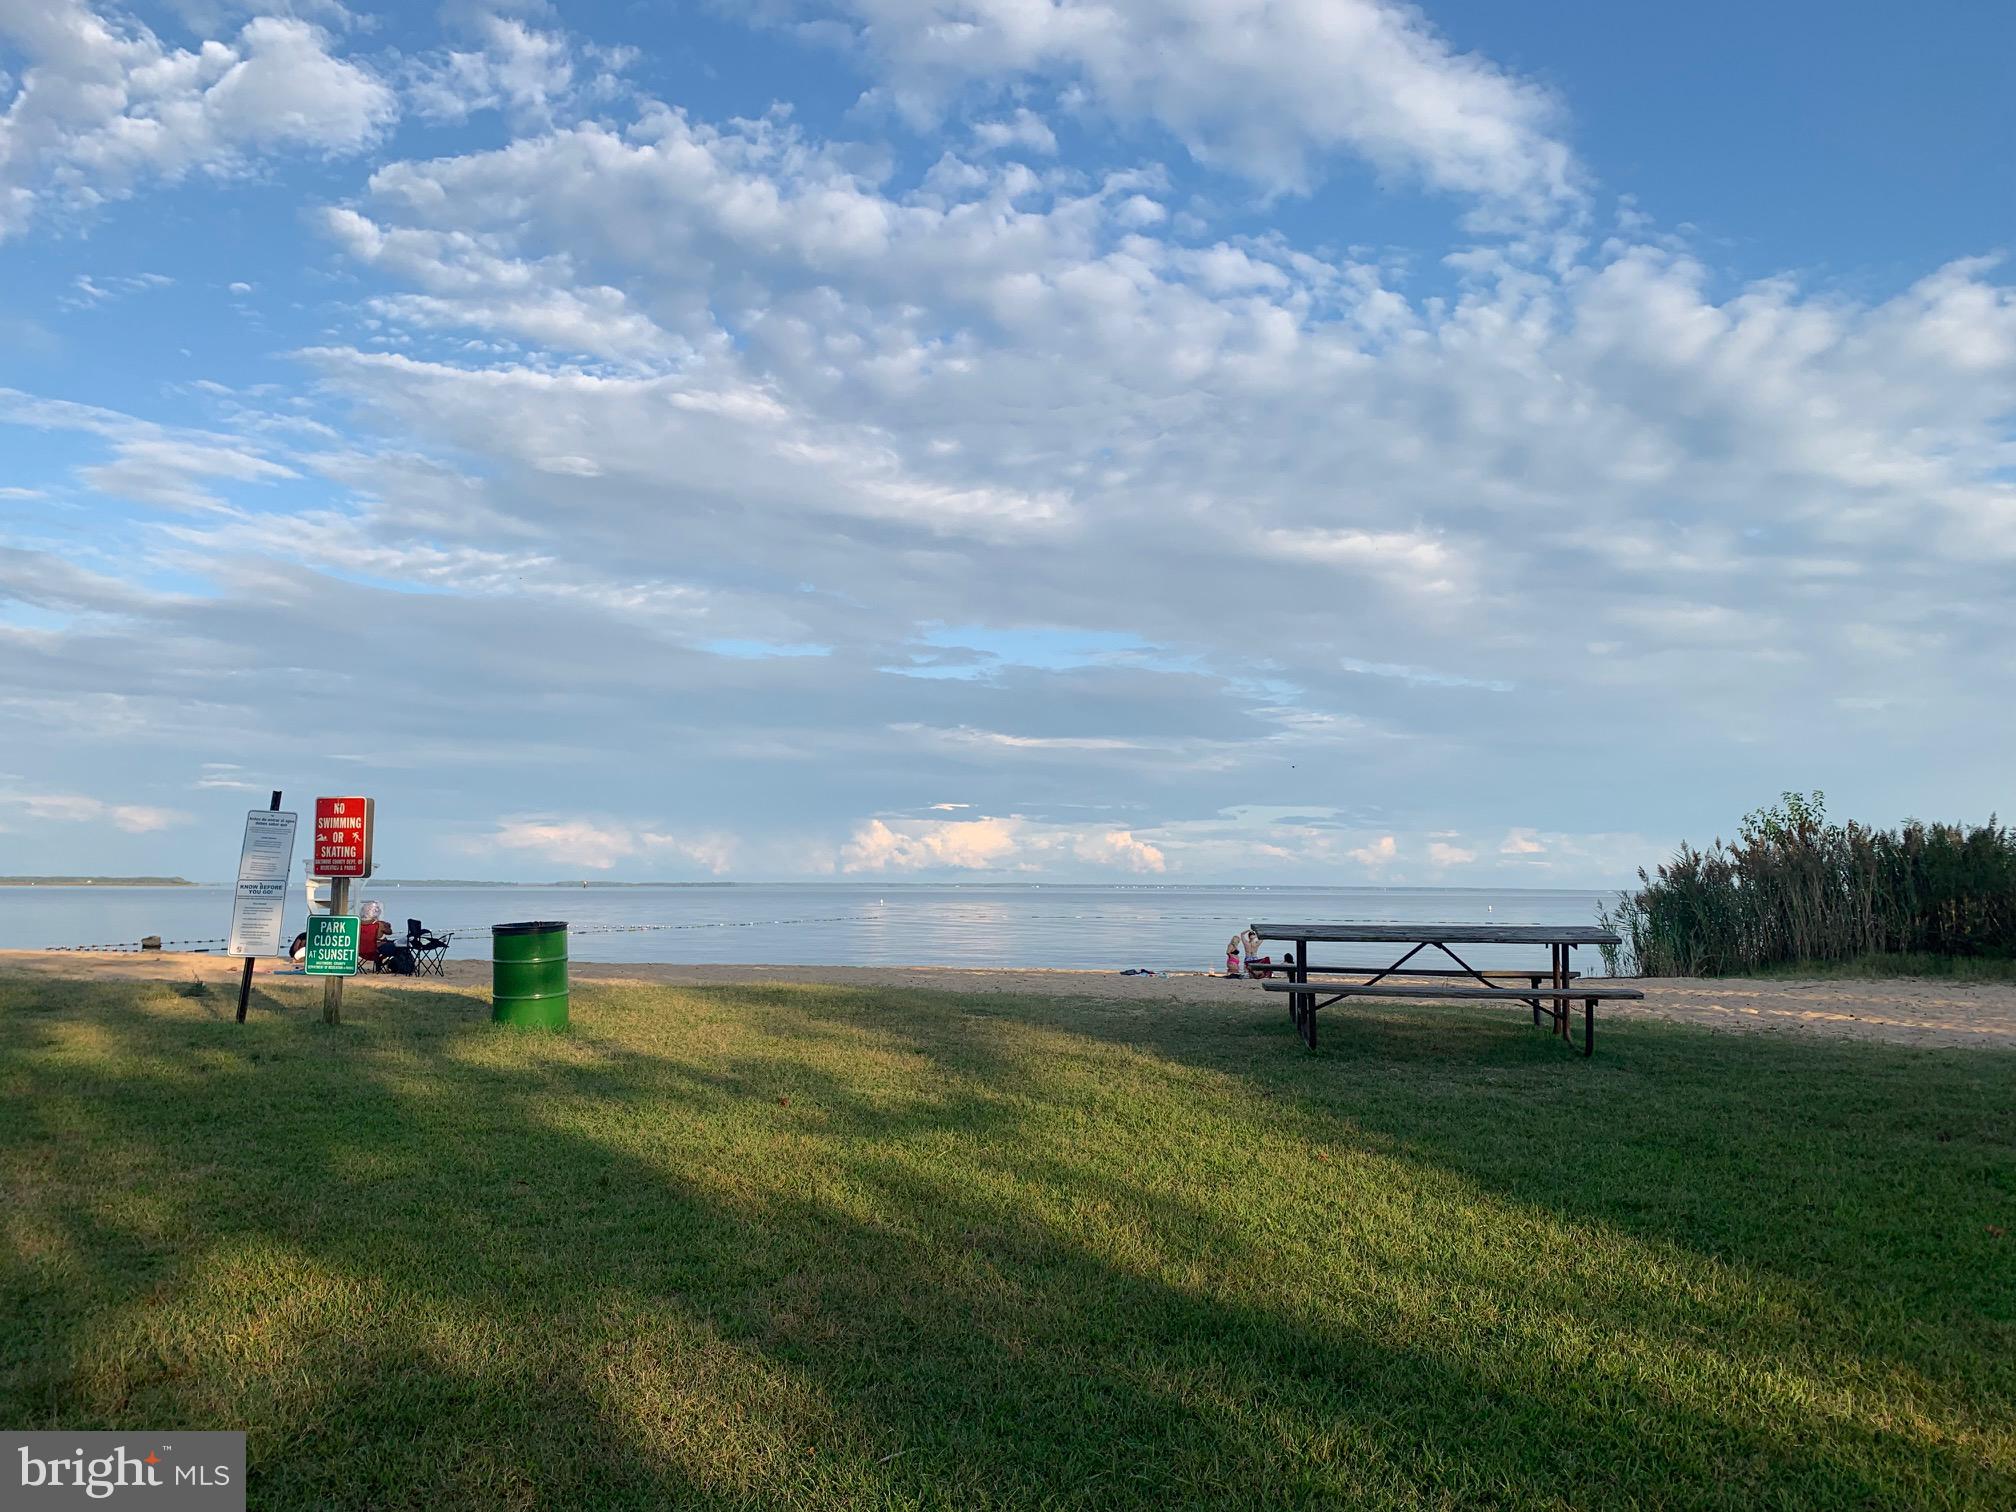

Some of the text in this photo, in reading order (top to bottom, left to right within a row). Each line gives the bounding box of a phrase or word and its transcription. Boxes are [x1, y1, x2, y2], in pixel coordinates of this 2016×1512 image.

[333, 802, 346, 815] NO
[318, 816, 362, 829] SWIMMING
[332, 831, 344, 844] OR
[320, 845, 357, 858] SKATING
[320, 921, 346, 933] PARK
[314, 934, 351, 947] CLOSED
[308, 948, 355, 961] AT SUNSET
